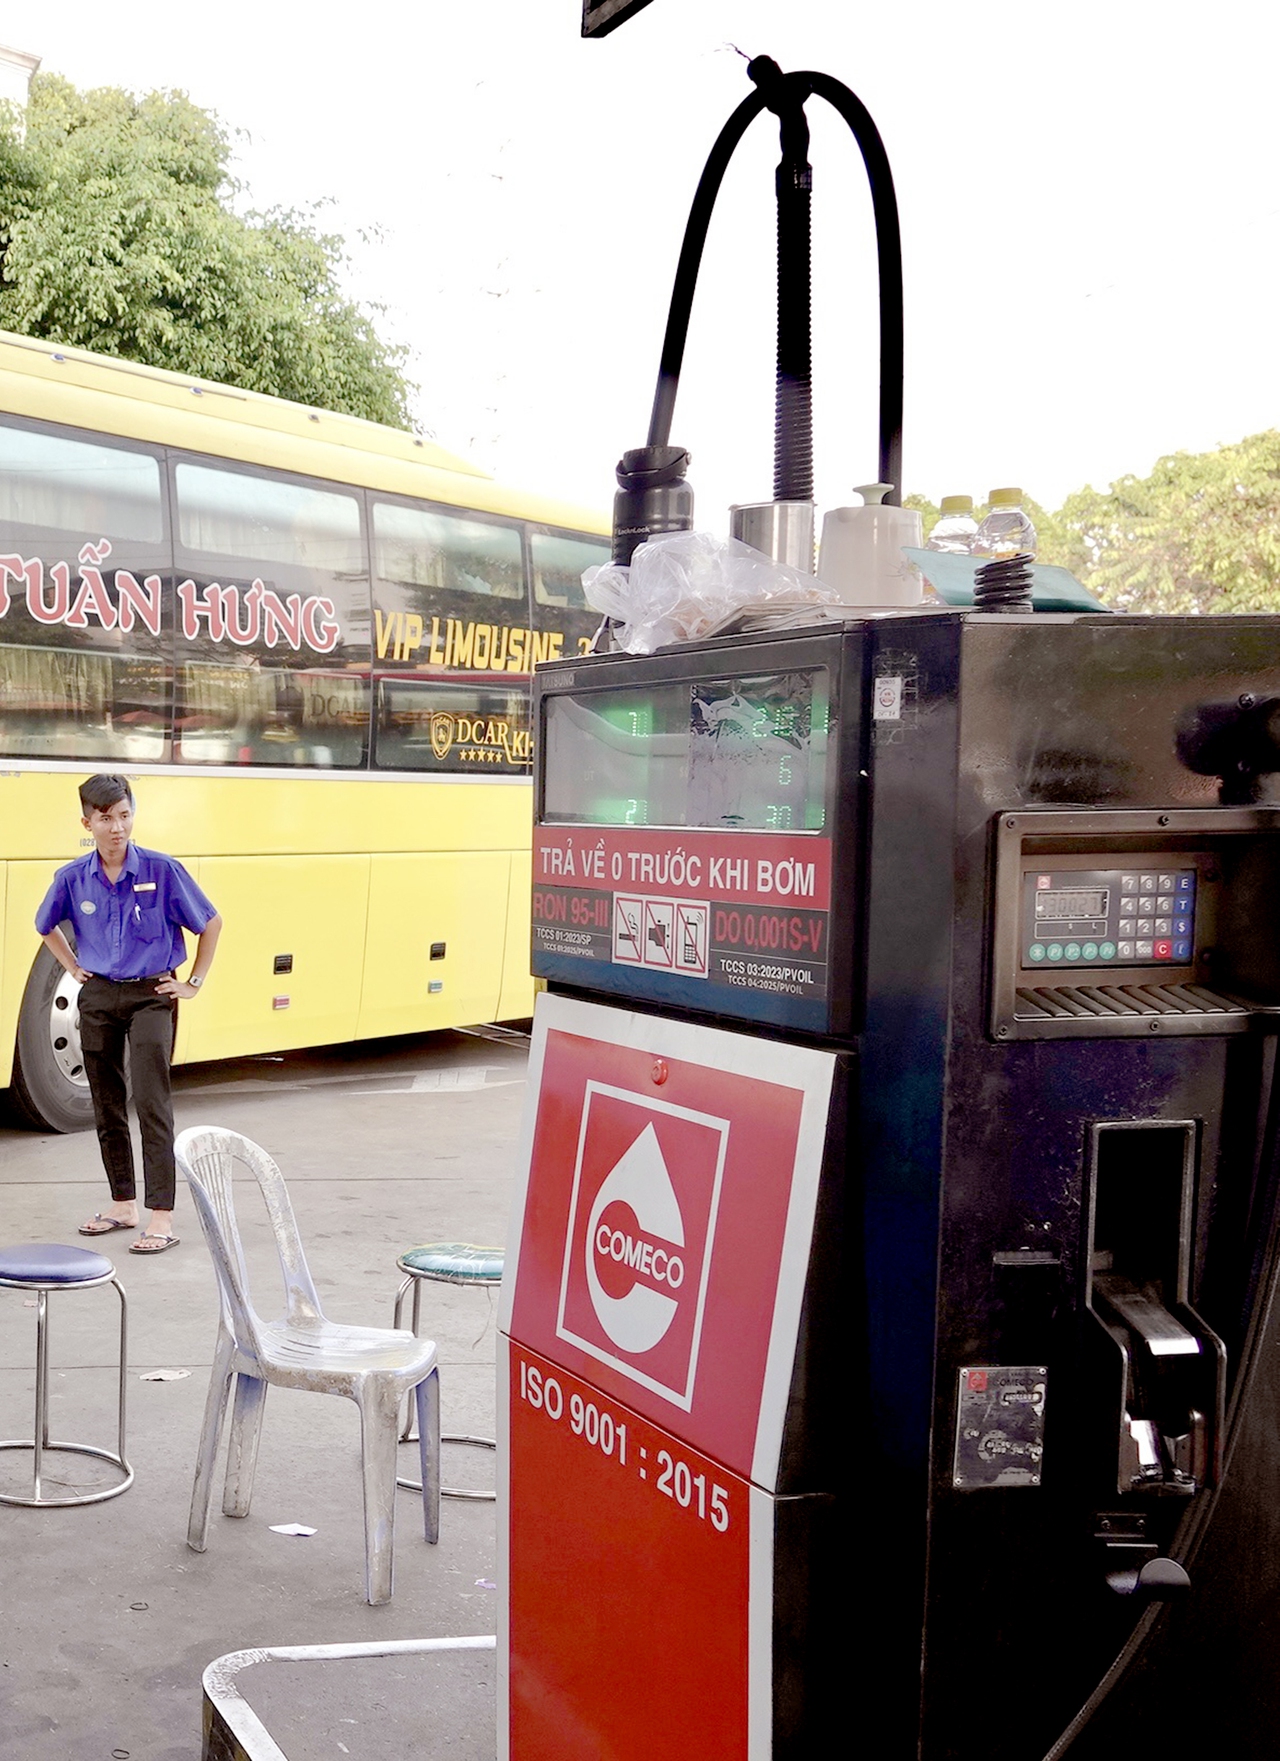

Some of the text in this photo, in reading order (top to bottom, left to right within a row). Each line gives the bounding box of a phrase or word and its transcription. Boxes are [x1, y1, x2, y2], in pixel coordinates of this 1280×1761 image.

[176, 578, 341, 654] HƯNG
[373, 608, 423, 662] VIP
[428, 616, 564, 676] LIMOUSINE
[541, 674, 575, 690] TATSUNO
[455, 717, 510, 746] DCAR
[540, 838, 815, 897] TRẢ VỀ 0 TRƯỚC KHI BƠM
[1127, 878, 1189, 889] 7 8 9 E
[533, 892, 609, 928] RON 95-III
[1126, 900, 1187, 911] 4 5 6 T
[536, 927, 554, 940] TCCS
[714, 910, 823, 953] DO 0,001S-V
[1142, 923, 1150, 933] 2
[1160, 922, 1167, 932] 3
[1123, 945, 1130, 955] 0
[1158, 944, 1167, 955] C
[720, 959, 814, 984] TCCS 03:2023/PVOIL
[728, 975, 747, 986] TCCS
[597, 1222, 685, 1290] COMECO
[519, 1360, 563, 1421] ISO
[569, 1393, 629, 1466] 9001
[656, 1450, 730, 1535] 2015
